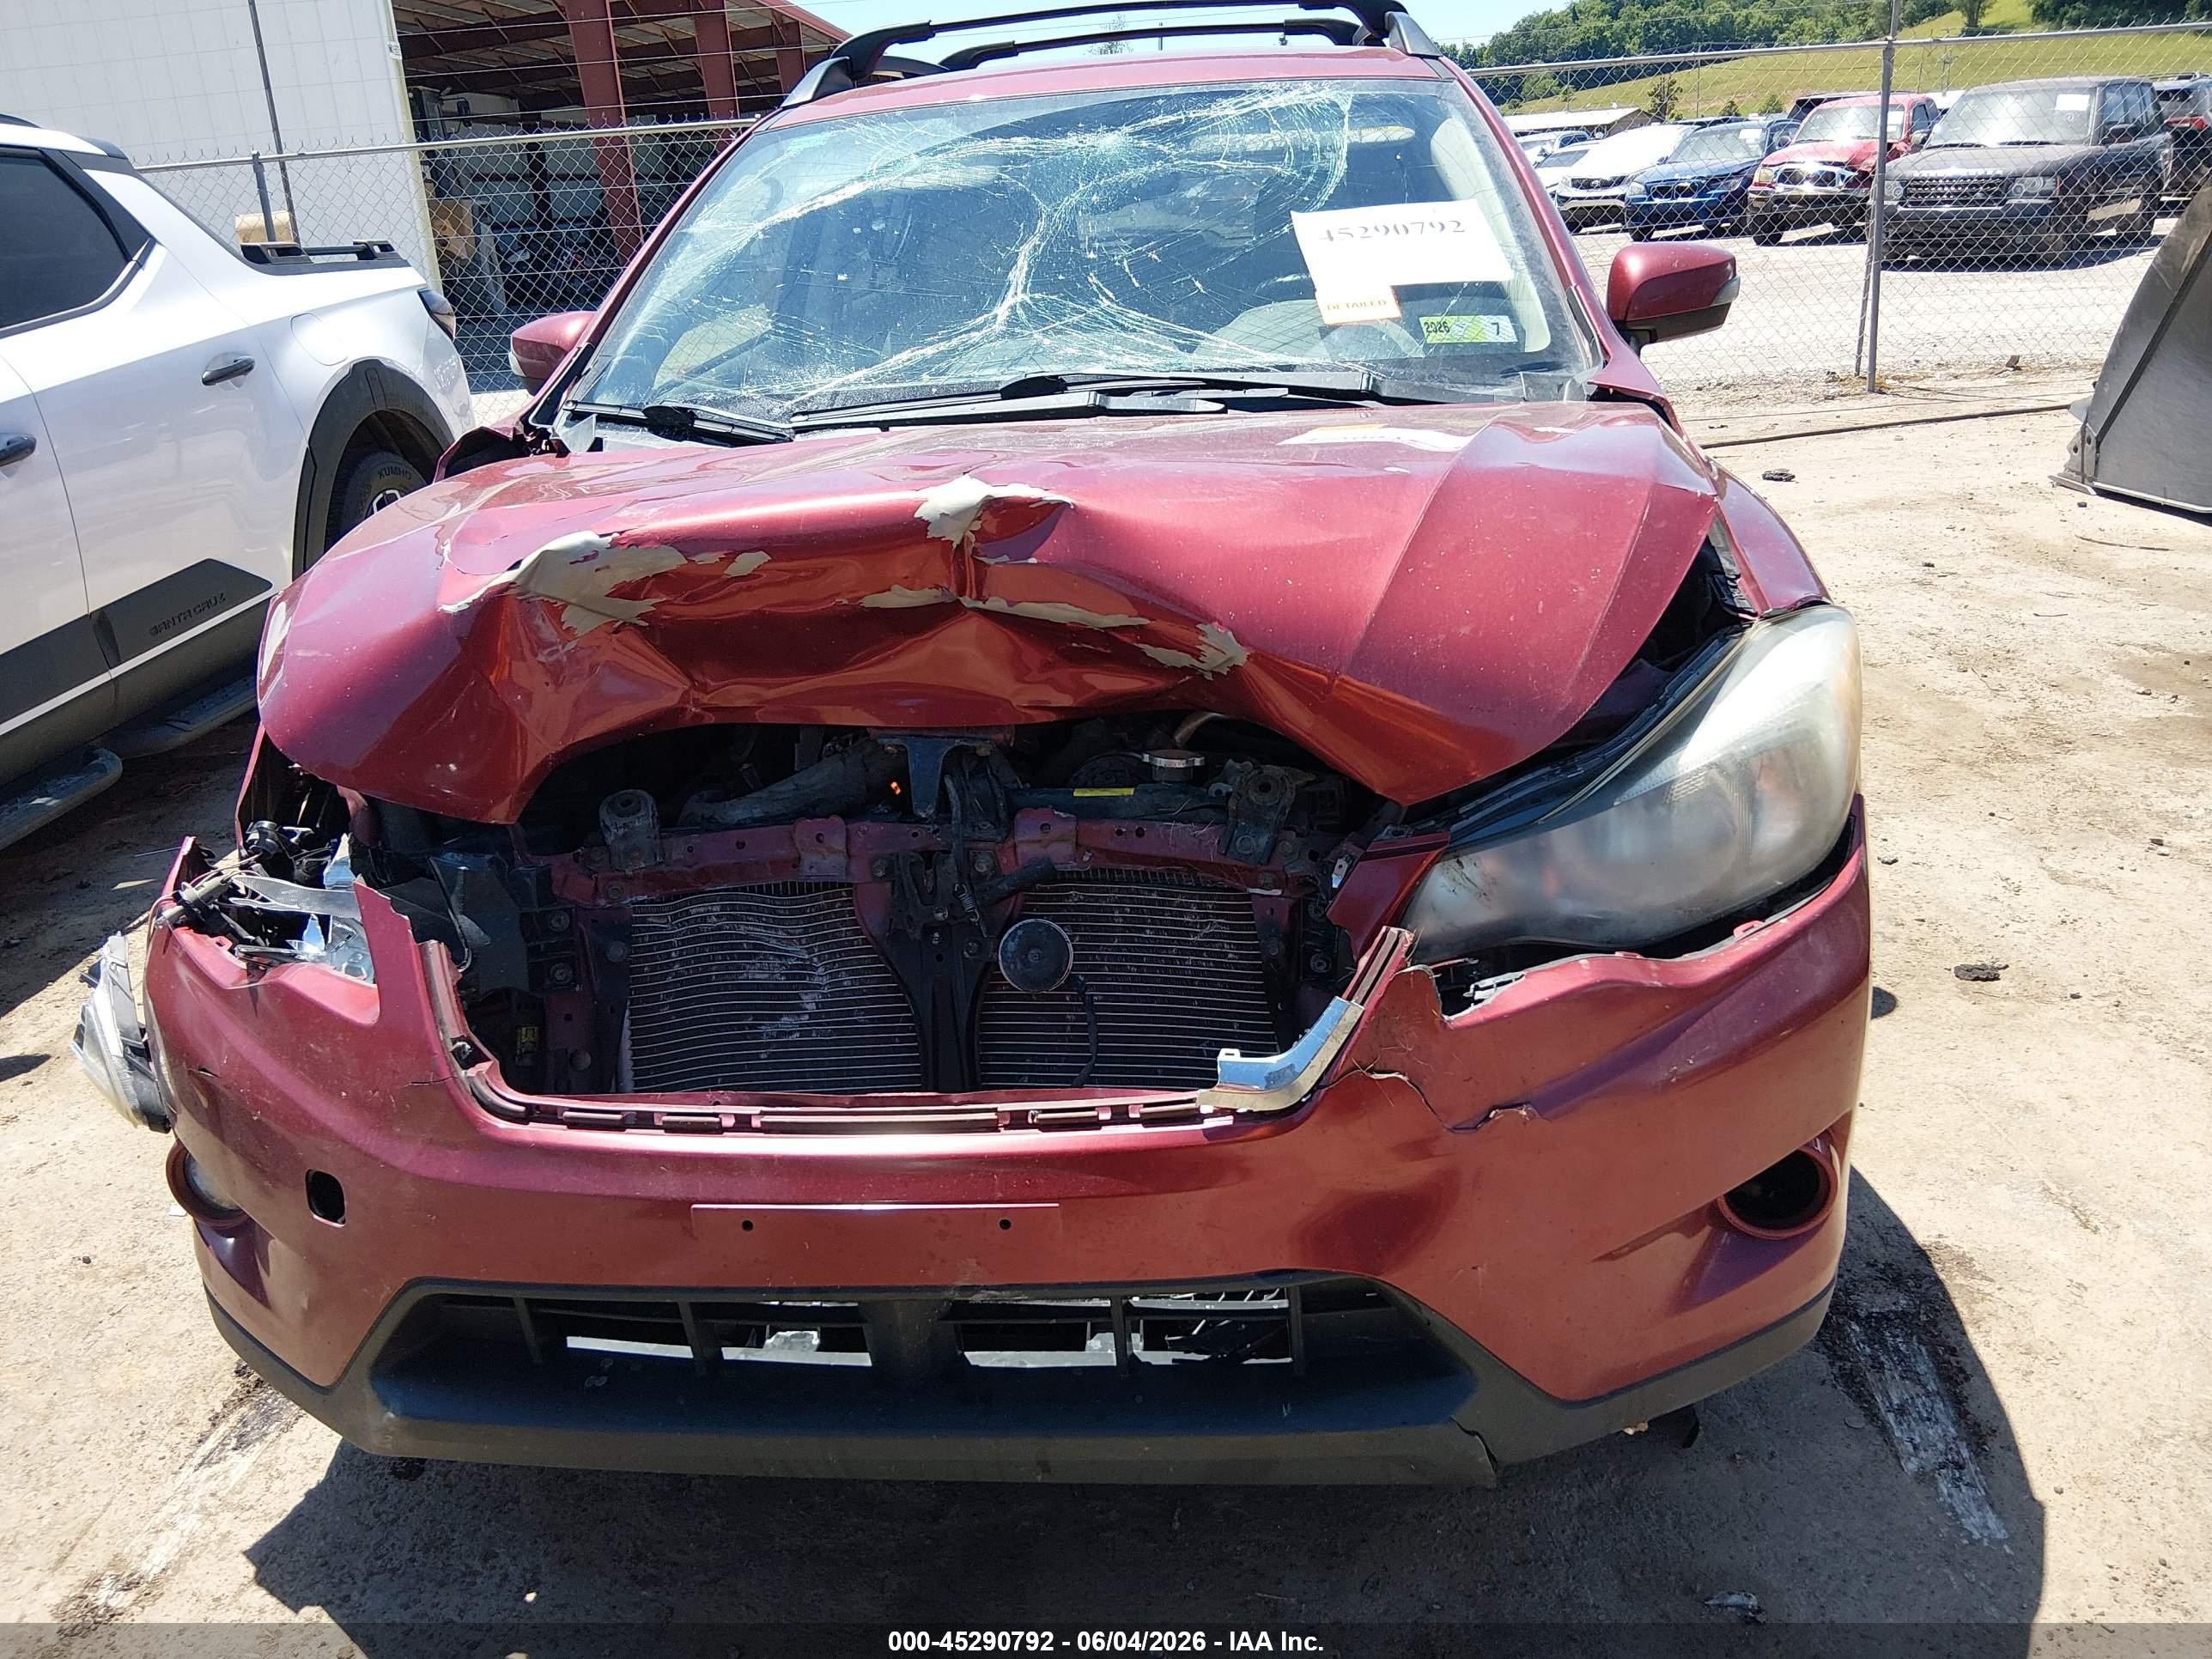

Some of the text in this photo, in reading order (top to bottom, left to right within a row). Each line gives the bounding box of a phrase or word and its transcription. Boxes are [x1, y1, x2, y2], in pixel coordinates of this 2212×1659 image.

[1320, 220, 1466, 242] 45290792
[1327, 300, 1387, 312] DETAILED
[1491, 322, 1500, 336] 7
[378, 466, 412, 480] KUMHO
[149, 610, 192, 635] SANTA
